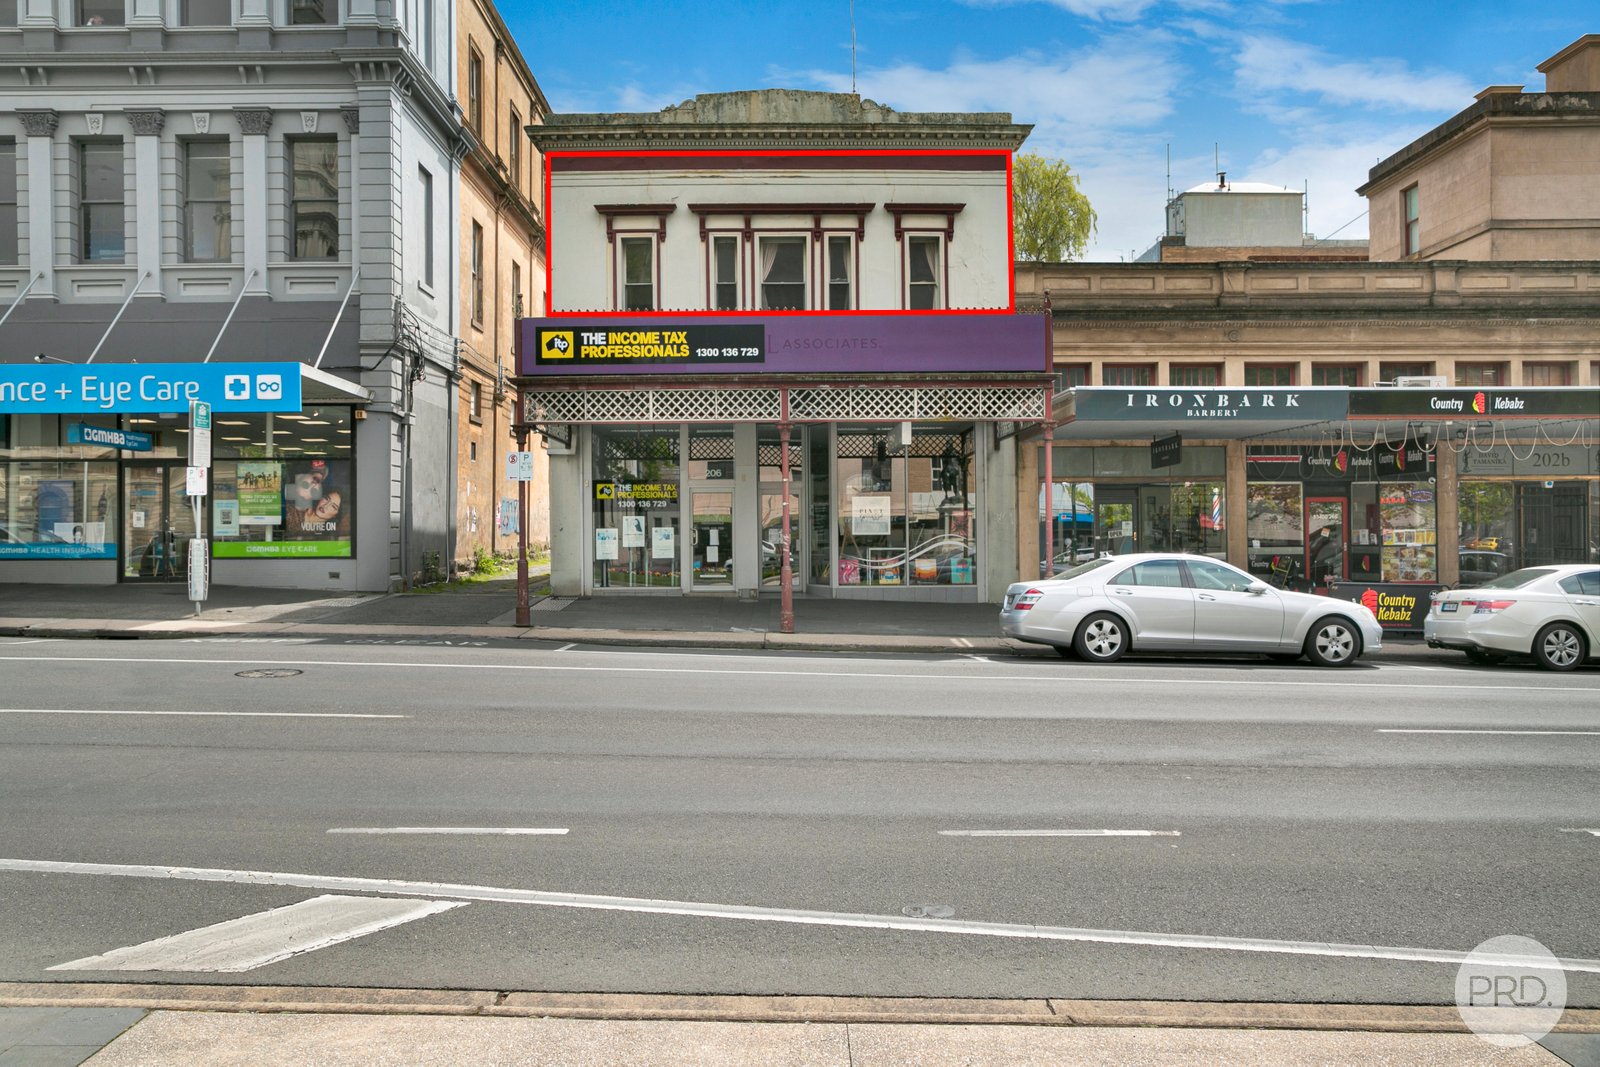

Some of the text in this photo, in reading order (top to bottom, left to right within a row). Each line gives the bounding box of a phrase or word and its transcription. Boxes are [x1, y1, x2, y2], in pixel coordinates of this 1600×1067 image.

[553, 337, 569, 351] itp
[580, 331, 688, 345] THE INCOME TAX
[580, 344, 690, 358] PROFESSIONALS
[696, 347, 759, 357] 1300 136 729
[81, 375, 134, 409] Eye
[140, 375, 200, 400] Care
[1127, 394, 1301, 407] IRONBARK
[1431, 397, 1525, 412] Country Kebabz
[1187, 409, 1239, 417] BARBERY
[1532, 452, 1571, 467] 202b
[705, 469, 722, 478] 206
[301, 522, 337, 531] YOU'RE ON
[1378, 592, 1416, 609] Country
[1377, 607, 1412, 620] Kebabz
